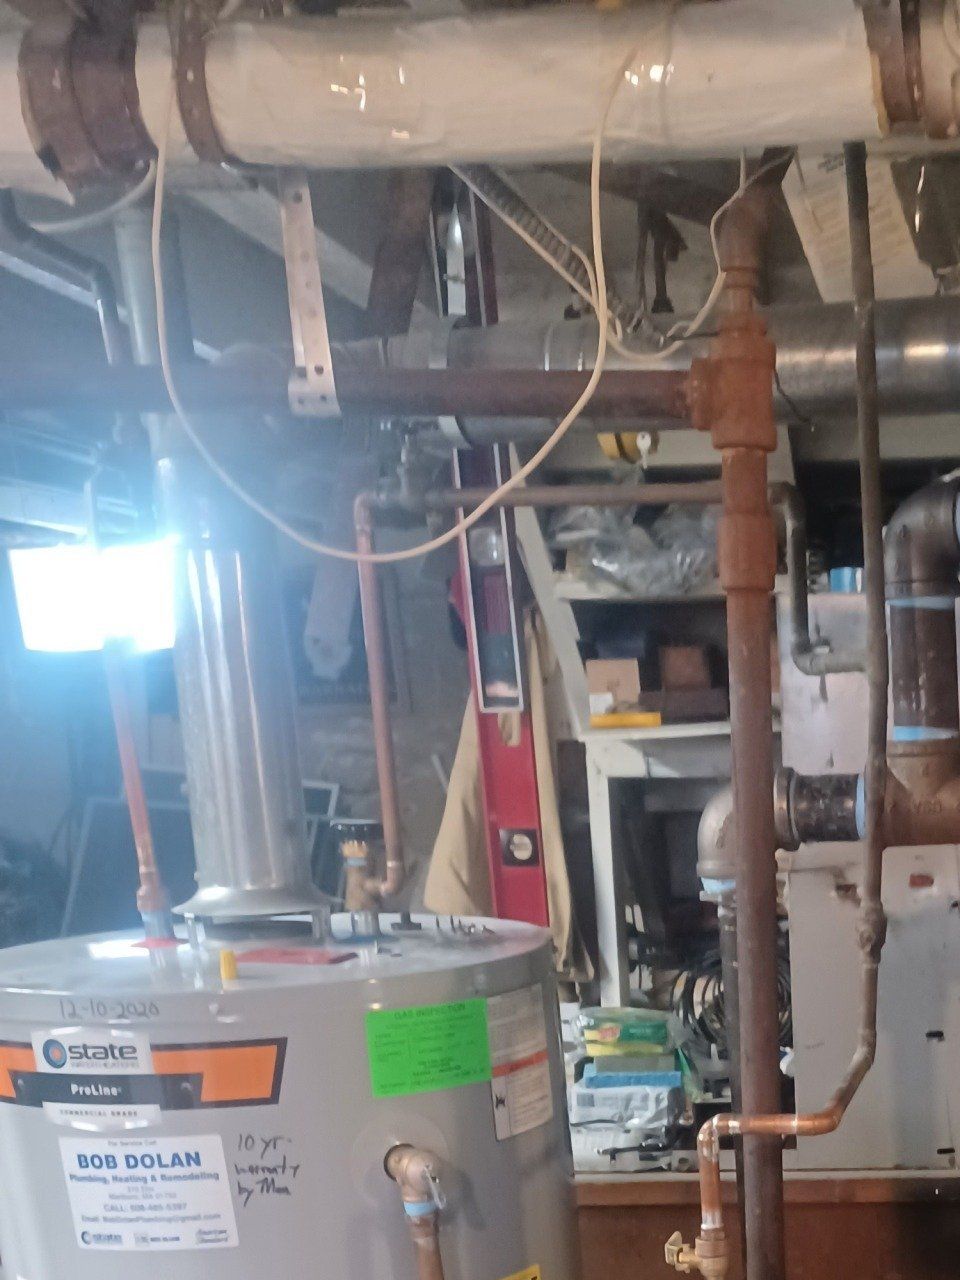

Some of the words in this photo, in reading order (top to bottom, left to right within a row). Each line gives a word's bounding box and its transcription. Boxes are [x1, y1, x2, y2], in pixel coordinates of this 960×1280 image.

[68, 1043, 138, 1060] state
[238, 1132, 255, 1151] 10
[77, 1153, 118, 1170] BOB
[124, 1151, 202, 1170] DOLAN
